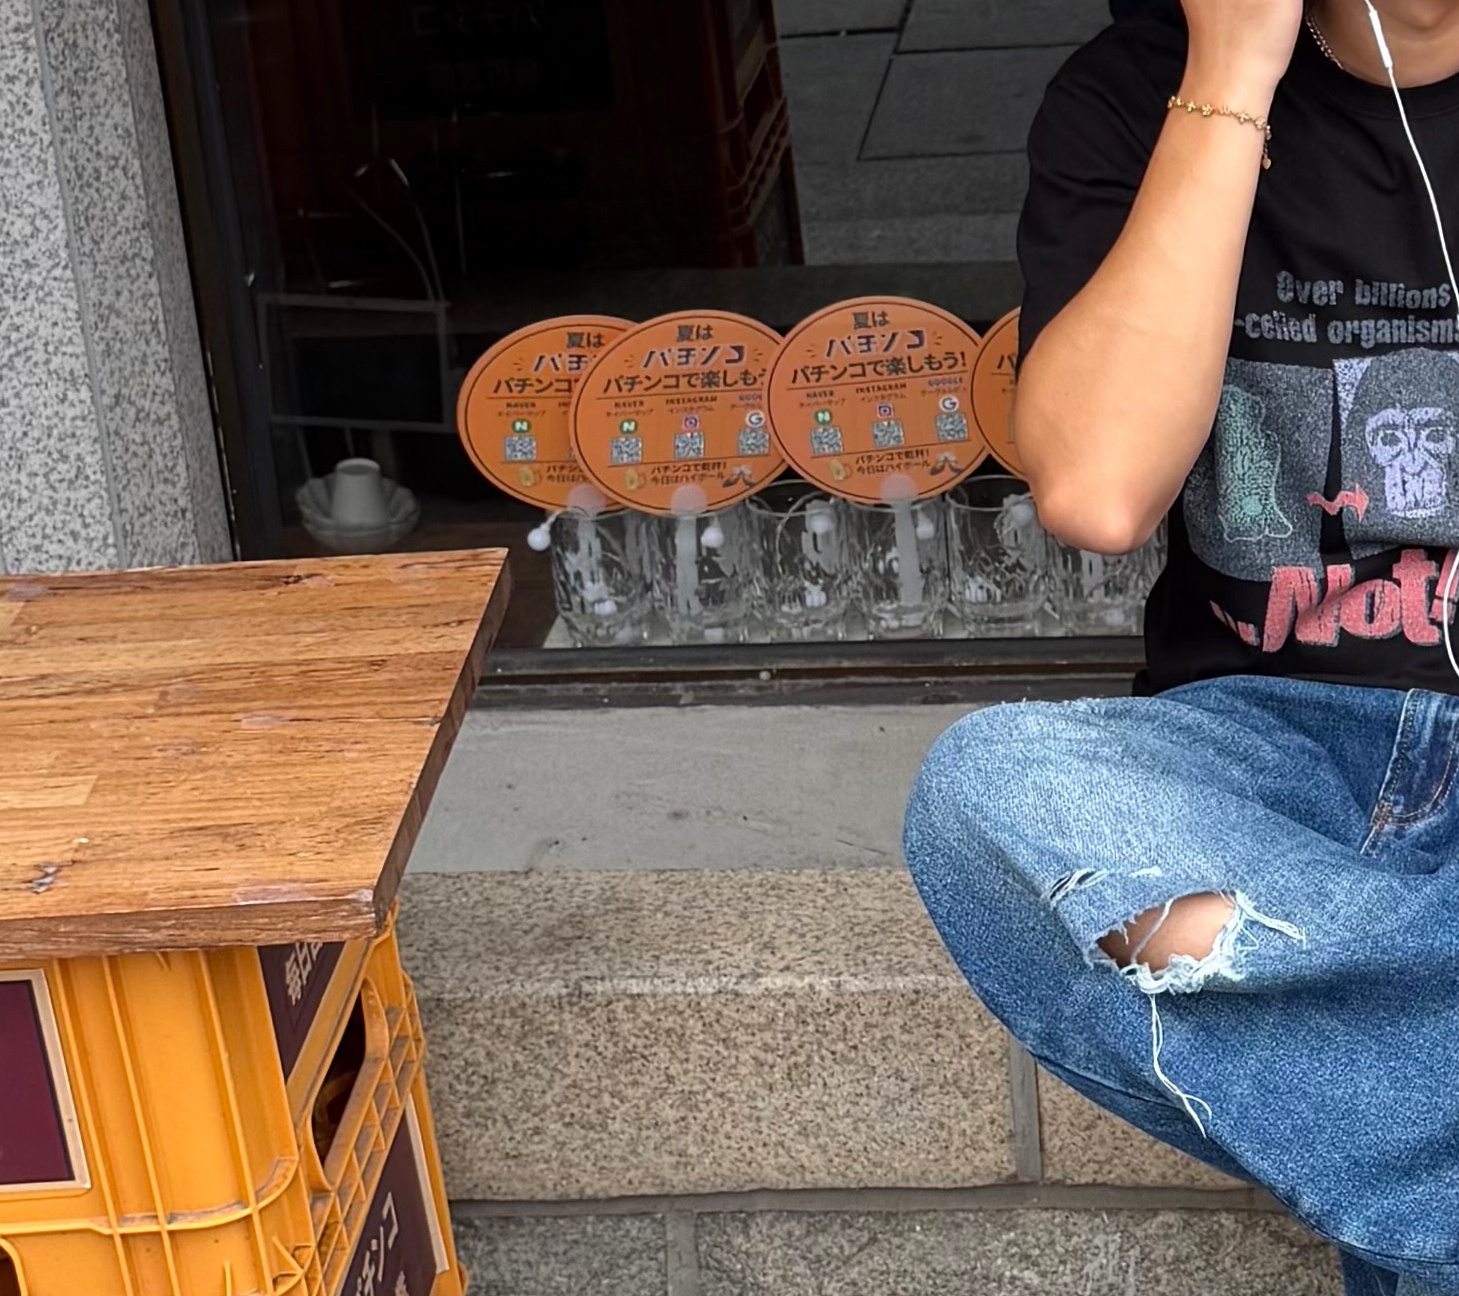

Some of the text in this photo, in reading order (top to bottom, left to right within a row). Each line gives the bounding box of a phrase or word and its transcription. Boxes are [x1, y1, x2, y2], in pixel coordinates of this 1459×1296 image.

[1276, 271, 1344, 306] Over
[1355, 278, 1451, 309] billions
[852, 311, 889, 329] 夏は
[567, 332, 605, 349] 夏は
[677, 325, 713, 342] 夏は
[827, 330, 924, 356] パチンコ
[534, 355, 597, 372] パチ
[643, 345, 745, 368] パチンコ
[792, 351, 966, 383] パチンコで楽しもう!
[494, 378, 579, 393] パチンコ
